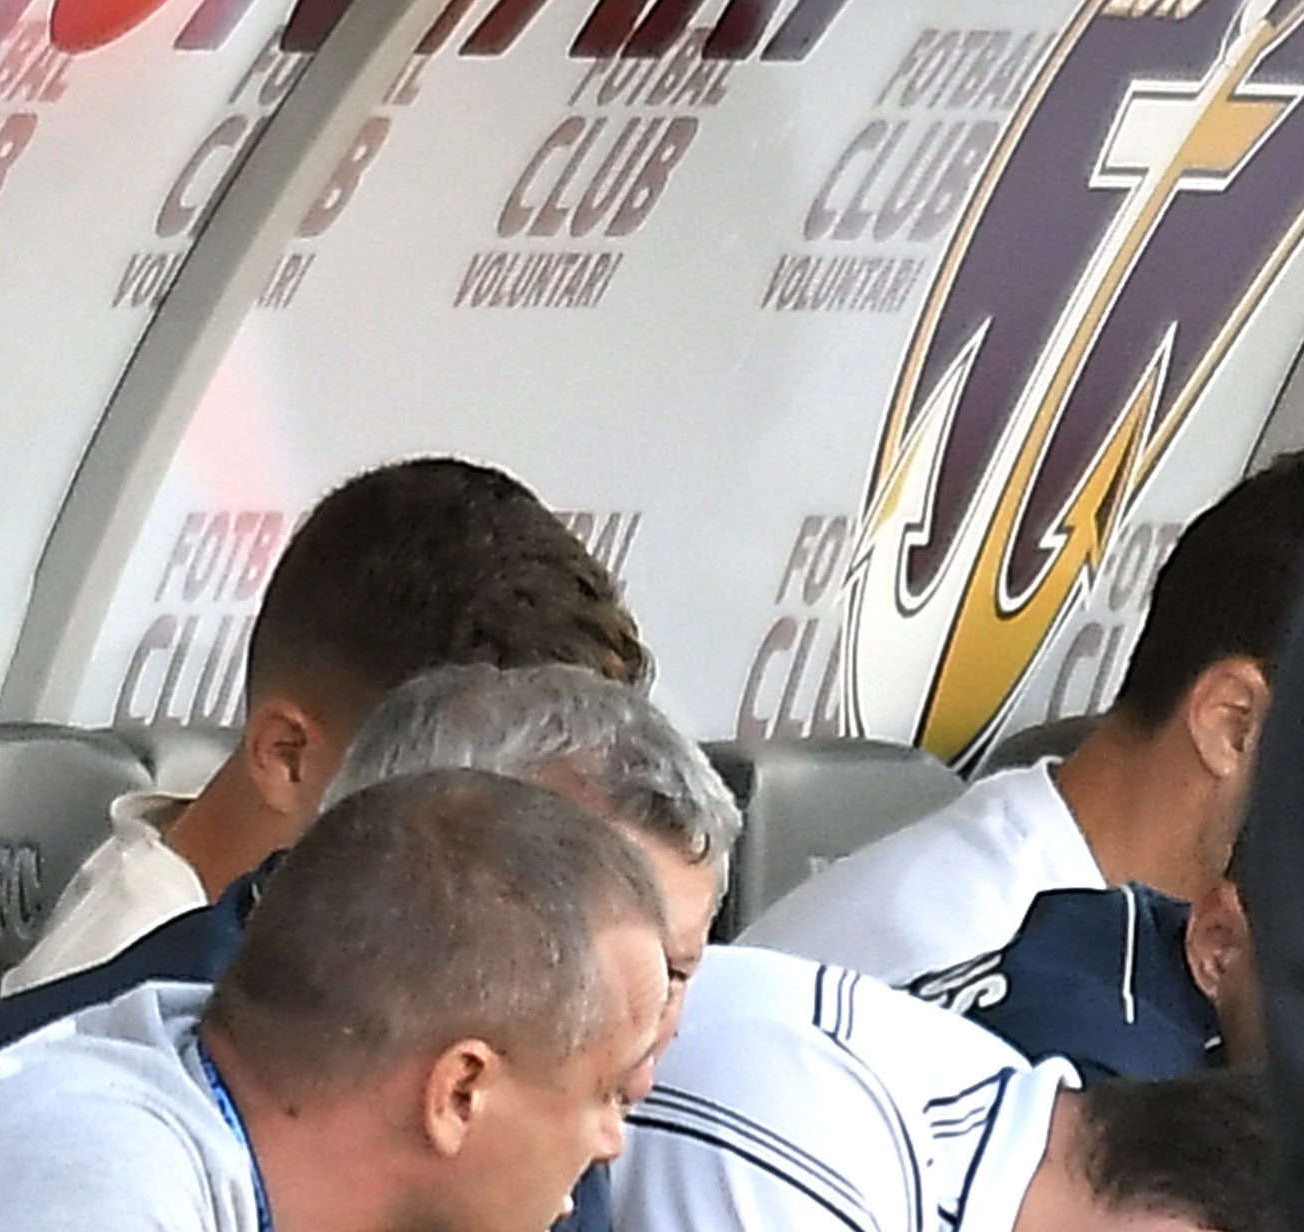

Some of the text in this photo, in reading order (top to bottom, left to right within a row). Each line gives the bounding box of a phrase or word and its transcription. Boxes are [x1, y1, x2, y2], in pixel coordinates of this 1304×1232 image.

[496, 116, 699, 237] CLUB
[804, 119, 1001, 240] CLUB
[454, 252, 623, 307] VOLUNTARI
[761, 254, 927, 311] VOLUNTARI
